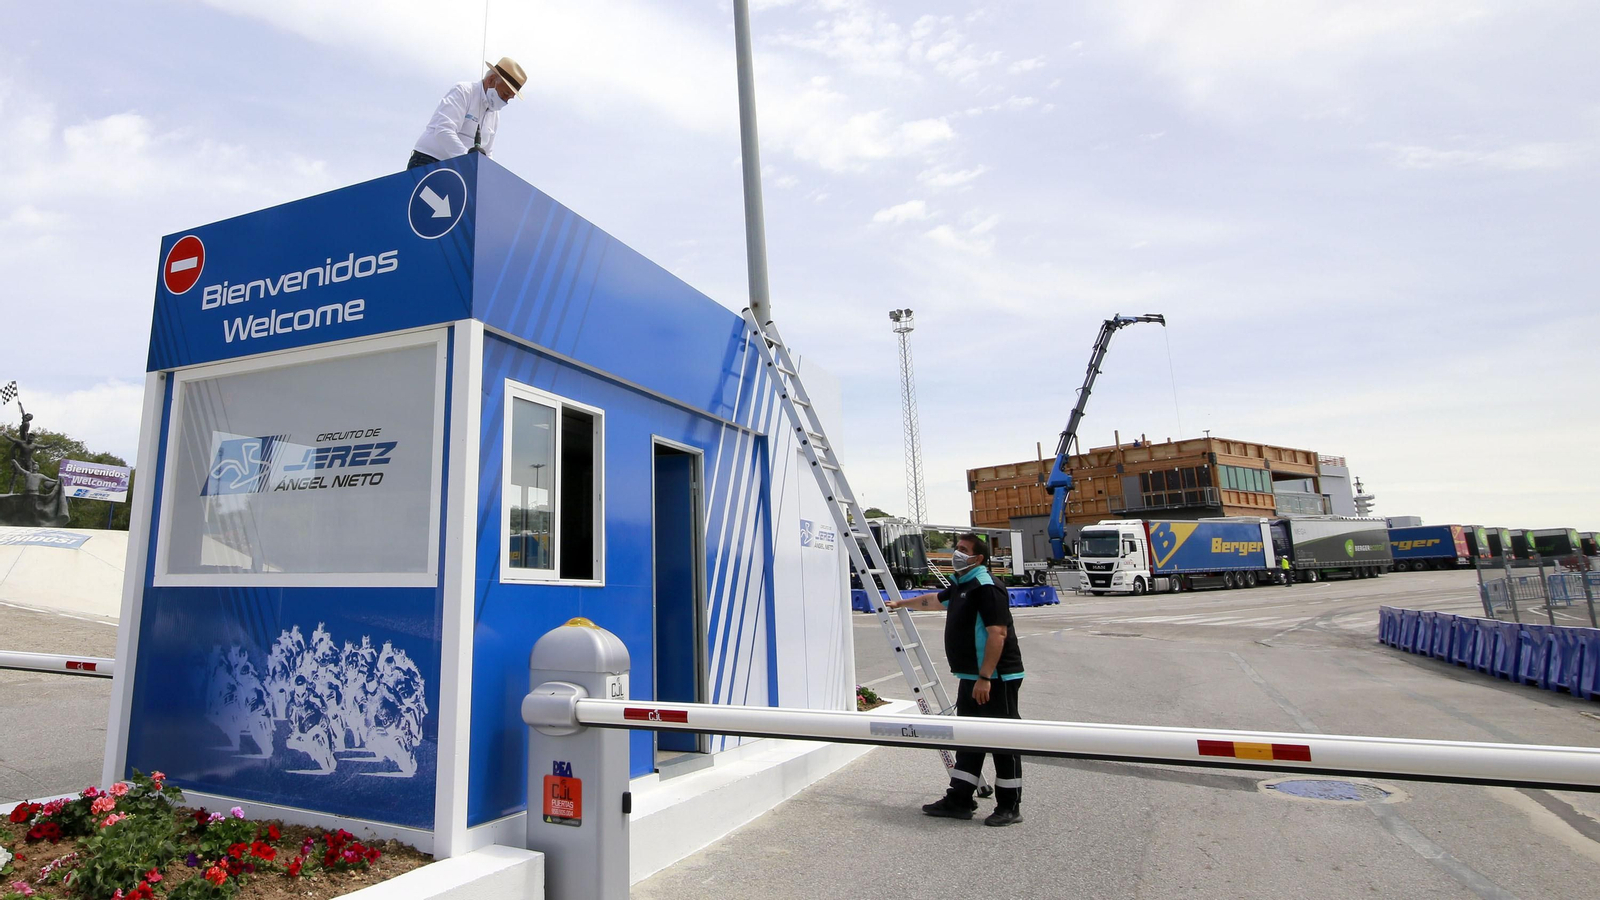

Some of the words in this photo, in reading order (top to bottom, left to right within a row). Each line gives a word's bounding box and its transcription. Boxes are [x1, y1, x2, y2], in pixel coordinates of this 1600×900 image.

[202, 250, 398, 310] Bienvenidos
[224, 299, 365, 343] Welcome
[316, 430, 364, 442] CIRCUITO
[365, 427, 382, 439] DE
[283, 441, 399, 472] JEREZ
[65, 463, 126, 478] Bienvenidos
[72, 476, 118, 487] Welcome
[274, 475, 328, 492] ÁNGEL
[331, 472, 384, 489] NIETO
[1211, 537, 1263, 556] Berger
[553, 760, 573, 778] DEA
